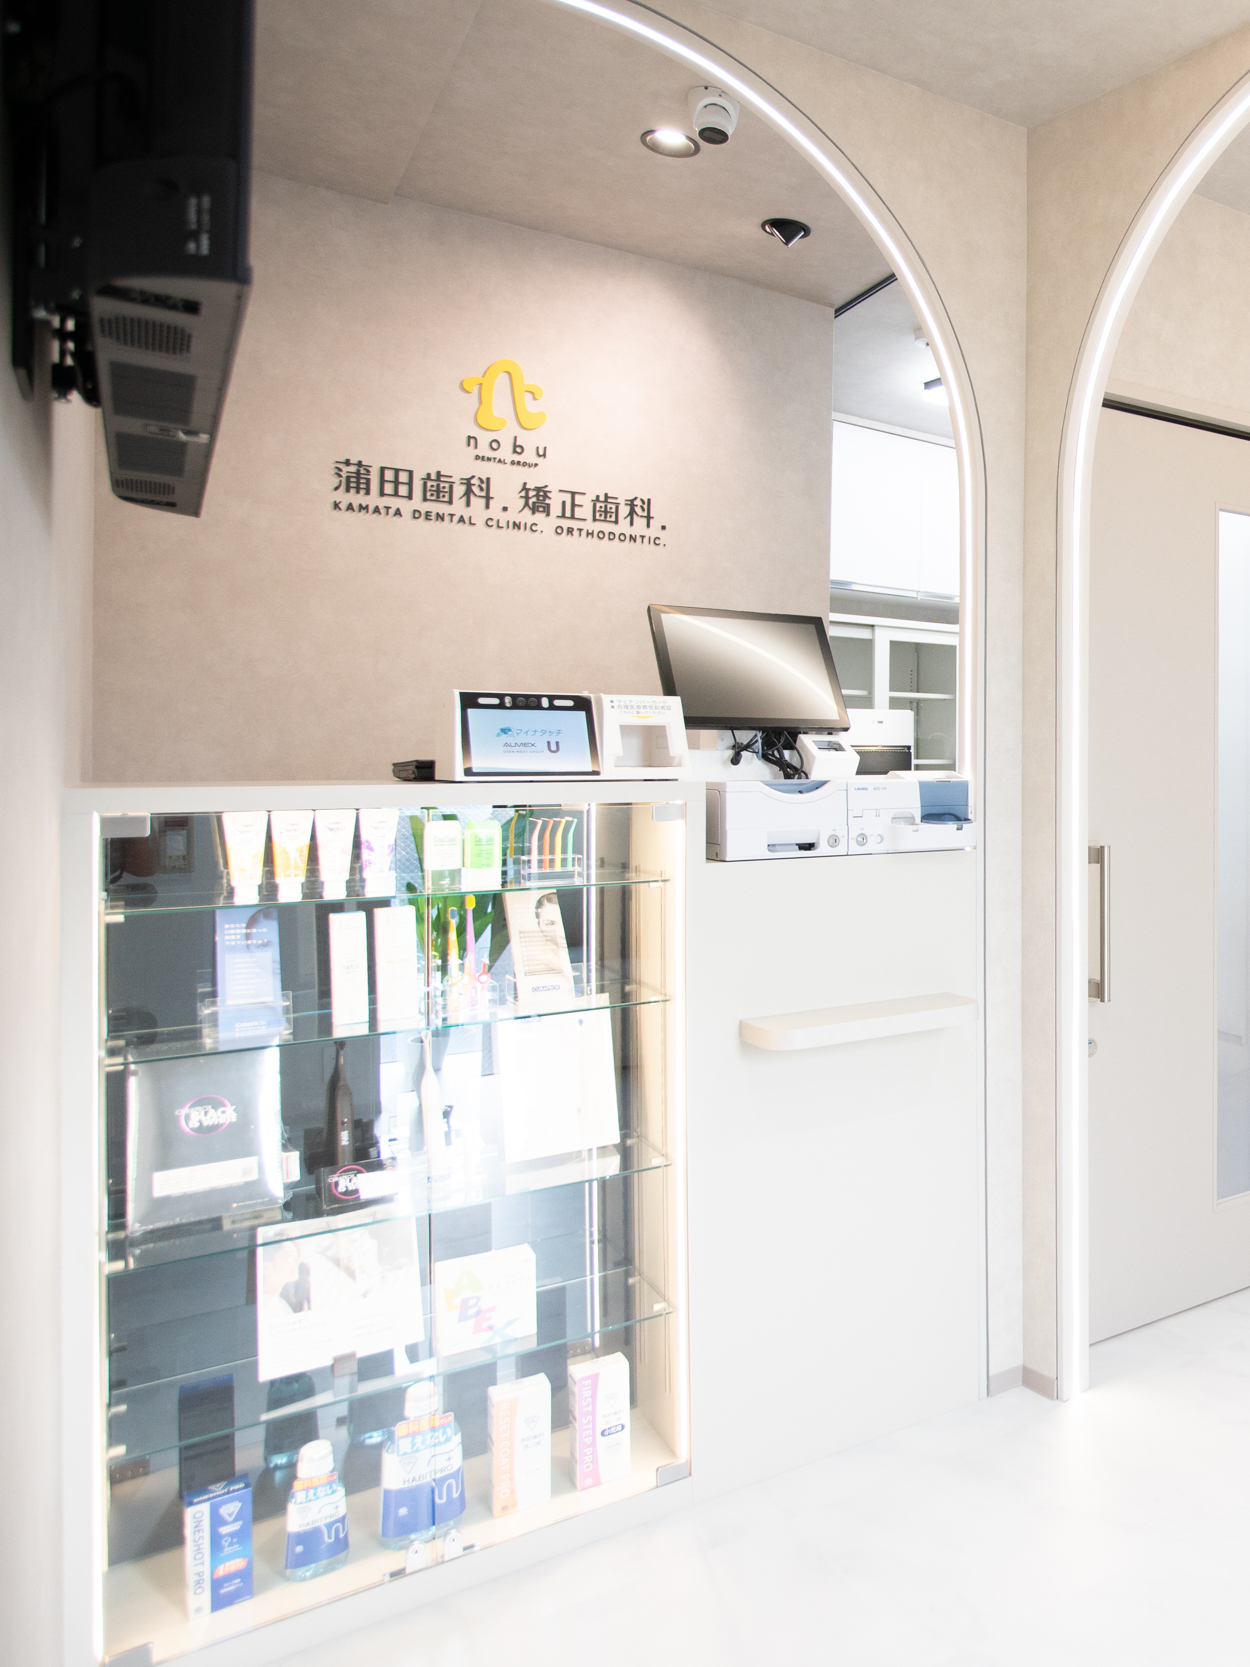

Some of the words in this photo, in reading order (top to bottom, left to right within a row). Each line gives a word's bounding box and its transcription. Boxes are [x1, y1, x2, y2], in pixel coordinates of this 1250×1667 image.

[467, 435, 547, 458] nobu
[475, 454, 507, 465] DENTAL
[510, 459, 539, 468] GROUP
[333, 501, 403, 518] KAMATA
[412, 509, 476, 526] DENTAL
[485, 517, 544, 534] CLINIC.
[554, 525, 667, 547] ORTHODONTIC.
[515, 728, 563, 737] マイナタッチ
[546, 740, 560, 754] U
[582, 1379, 592, 1412] FIRST
[500, 1401, 510, 1438] RESET
[582, 1415, 592, 1444] STEP
[499, 1441, 510, 1471] COAT
[583, 1447, 593, 1472] PRO
[193, 1487, 228, 1502] ONESHOT
[500, 1474, 510, 1499] PRO
[193, 1510, 206, 1568] ONESHOT
[193, 1570, 206, 1596] PRO
